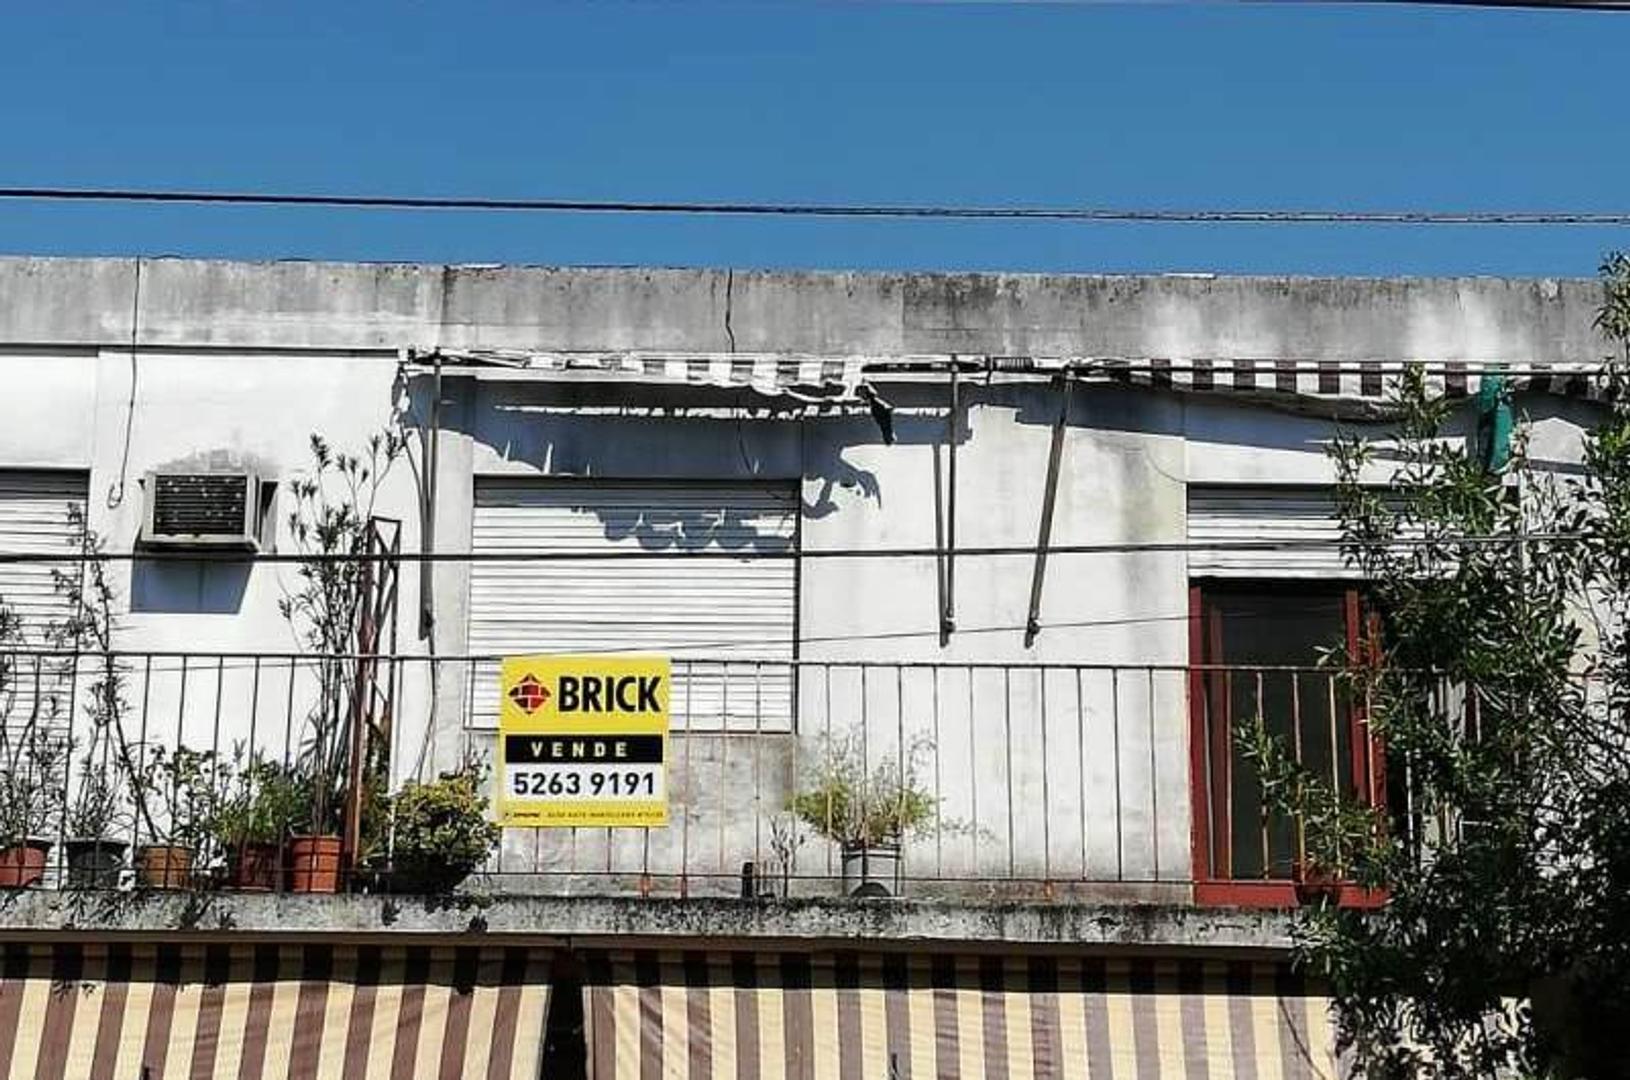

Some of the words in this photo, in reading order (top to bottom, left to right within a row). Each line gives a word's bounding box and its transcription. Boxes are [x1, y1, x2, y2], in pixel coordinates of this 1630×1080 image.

[558, 676, 662, 712] BRICK
[531, 742, 627, 757] VENDE
[514, 772, 580, 795] 5263
[590, 772, 654, 795] 9191
